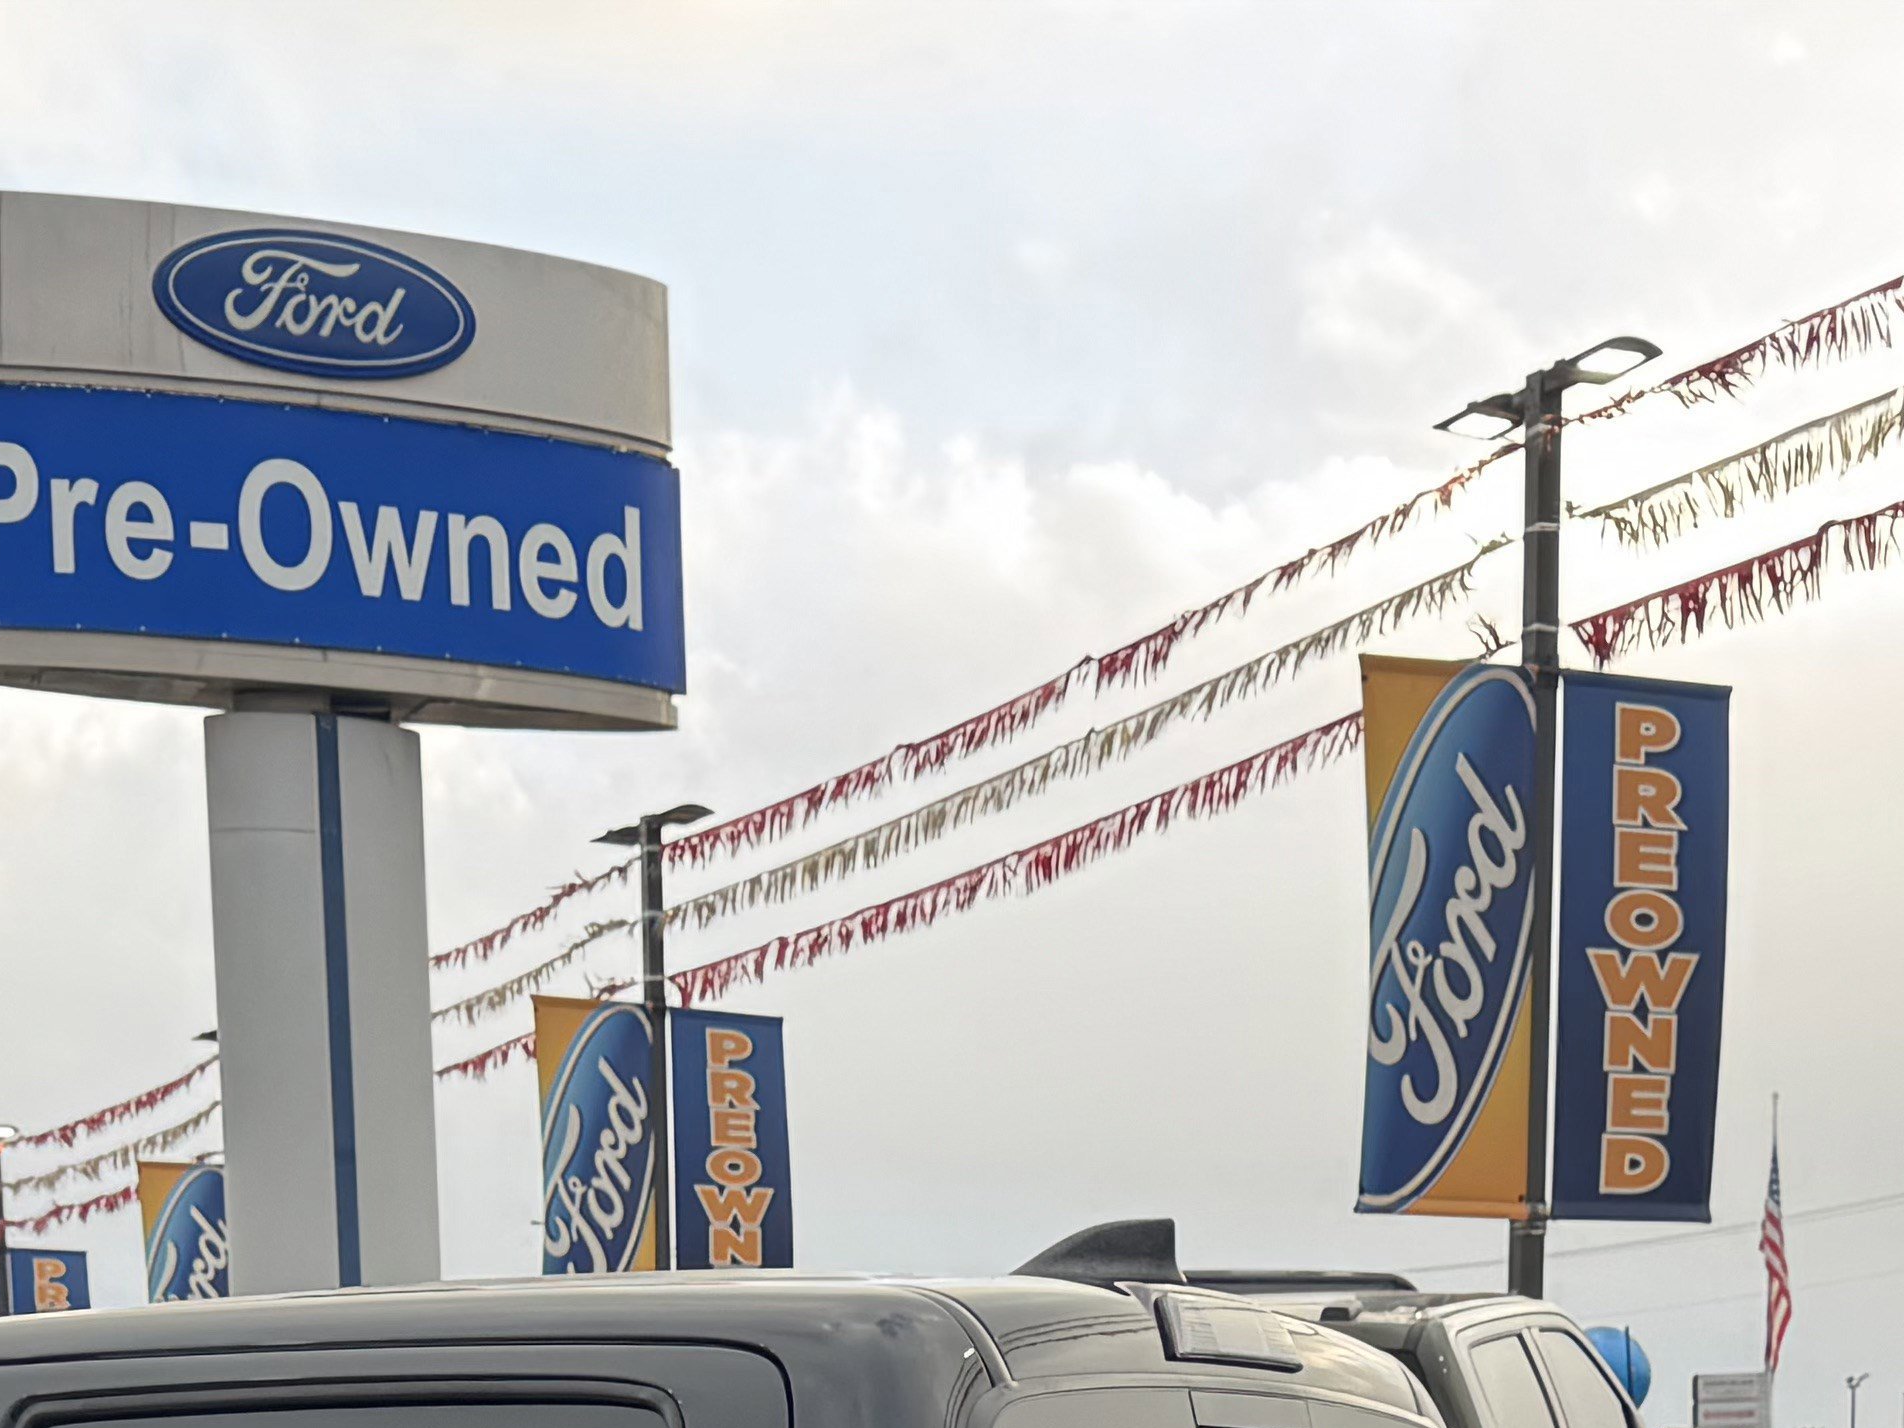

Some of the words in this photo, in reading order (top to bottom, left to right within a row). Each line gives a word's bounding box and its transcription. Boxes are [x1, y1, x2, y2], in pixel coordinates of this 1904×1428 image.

[223, 248, 404, 347] Ford
[1368, 752, 1528, 1126] Ford
[1585, 701, 1701, 1195] PREOWNED
[544, 1055, 649, 1273] Ford
[694, 1026, 775, 1269] PREOWN
